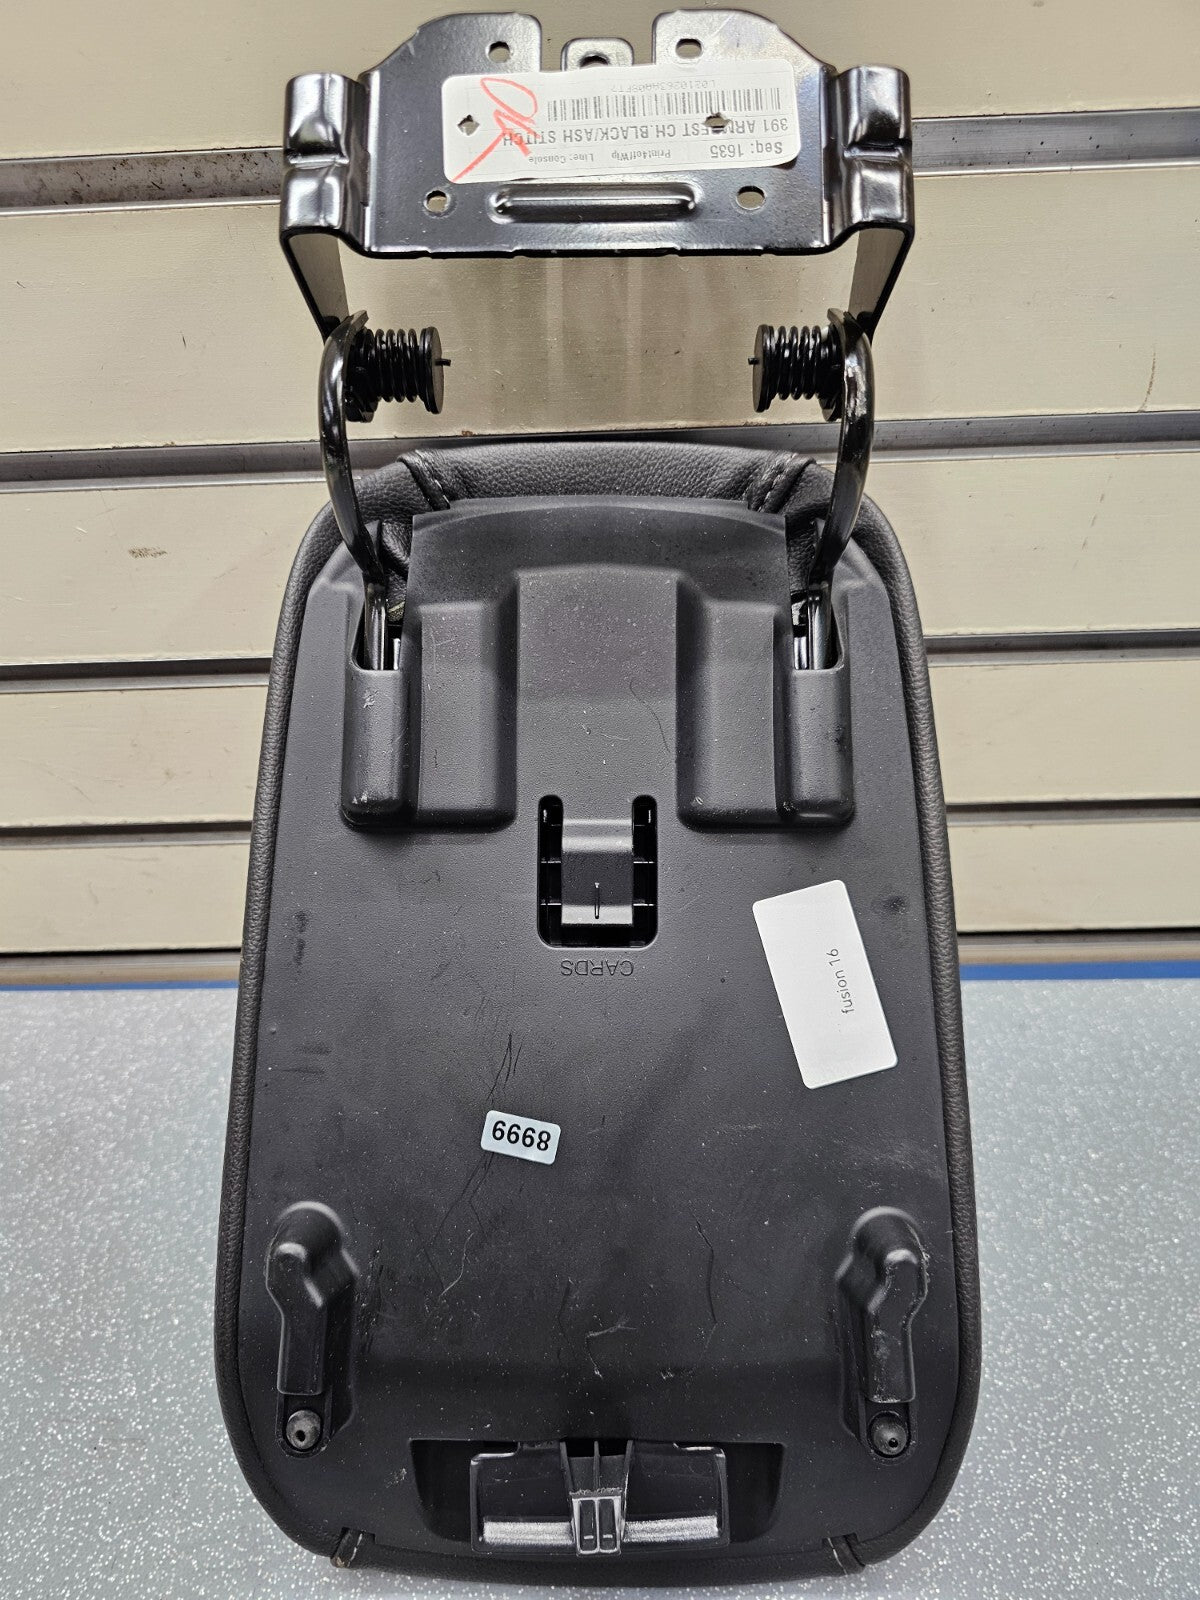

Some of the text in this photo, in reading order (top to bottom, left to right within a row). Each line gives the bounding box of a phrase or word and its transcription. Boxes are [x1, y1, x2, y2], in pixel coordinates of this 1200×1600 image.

[503, 117, 789, 147] 391 ARMEST CH.BLACK/ASH STITCH
[528, 153, 594, 164] Line: Console
[709, 141, 783, 159] Seq: 1635
[560, 959, 634, 977] CARDS
[826, 948, 855, 1014] fusion 16
